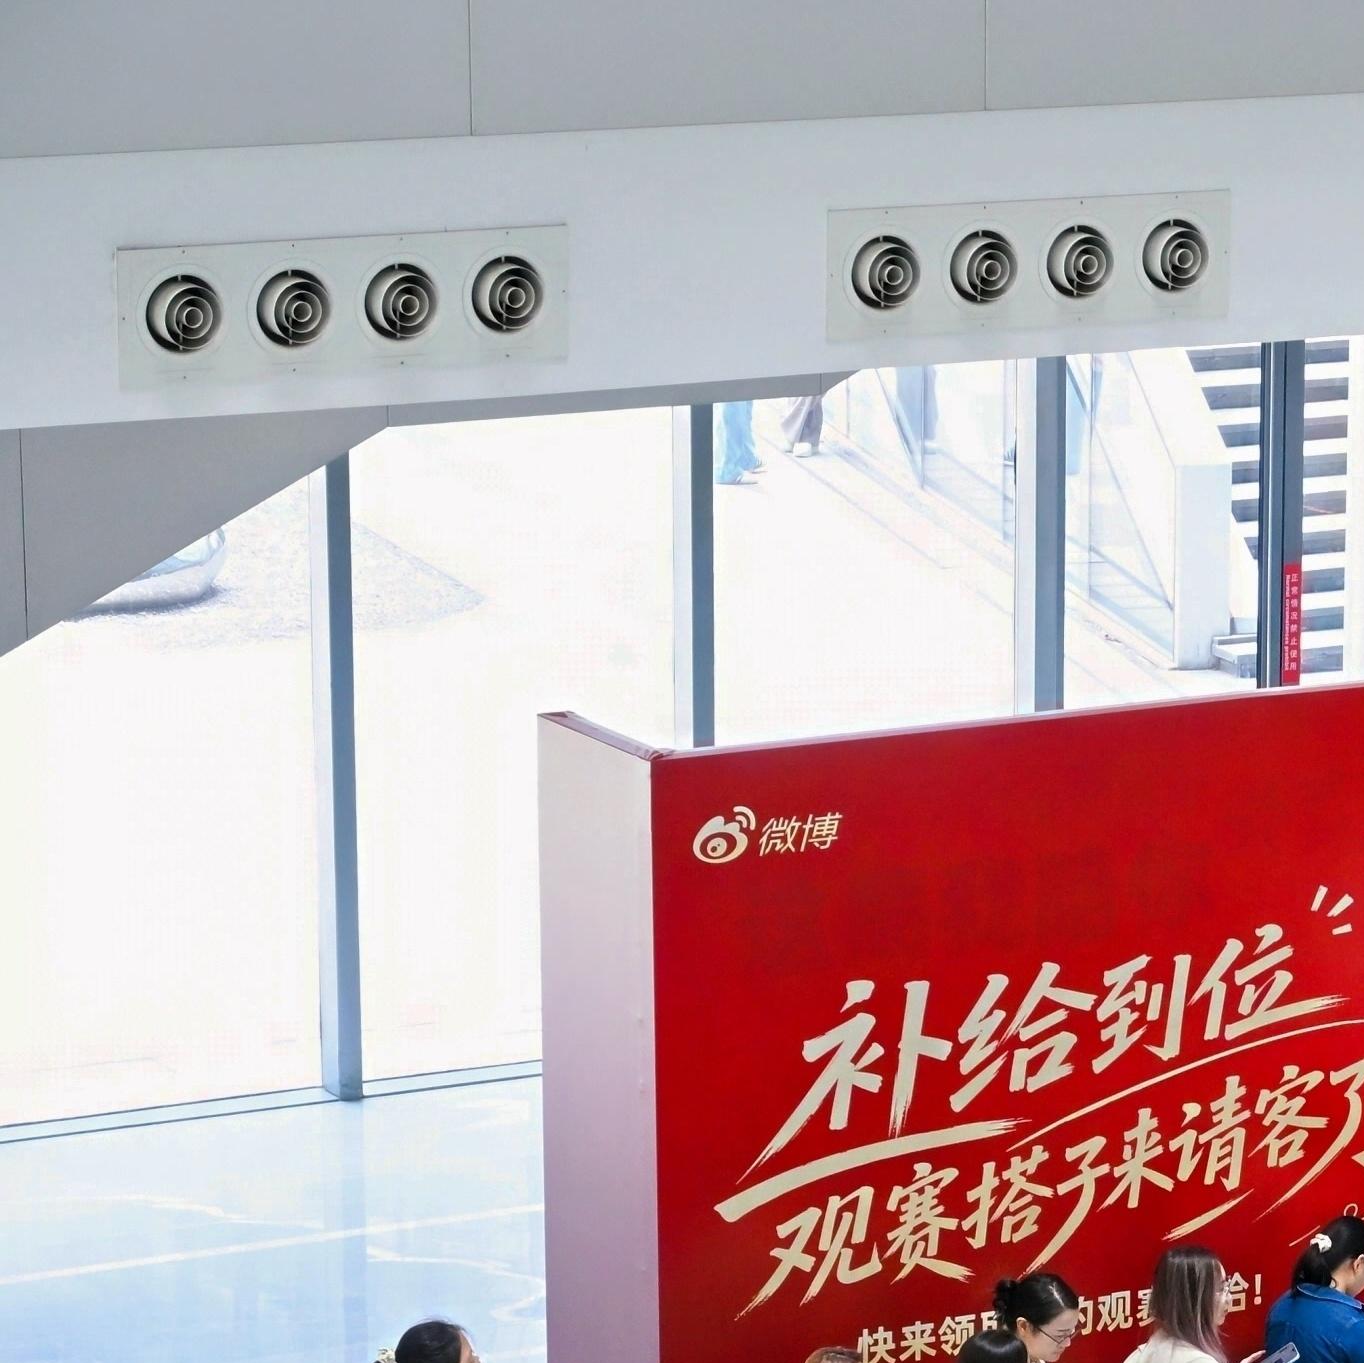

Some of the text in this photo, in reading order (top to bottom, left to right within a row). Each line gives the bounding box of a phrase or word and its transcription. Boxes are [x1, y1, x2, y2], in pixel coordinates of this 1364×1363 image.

[1289, 573, 1299, 671] 正常情况禁止使用
[758, 812, 843, 857] 微博
[740, 924, 1345, 1178] 补给到位
